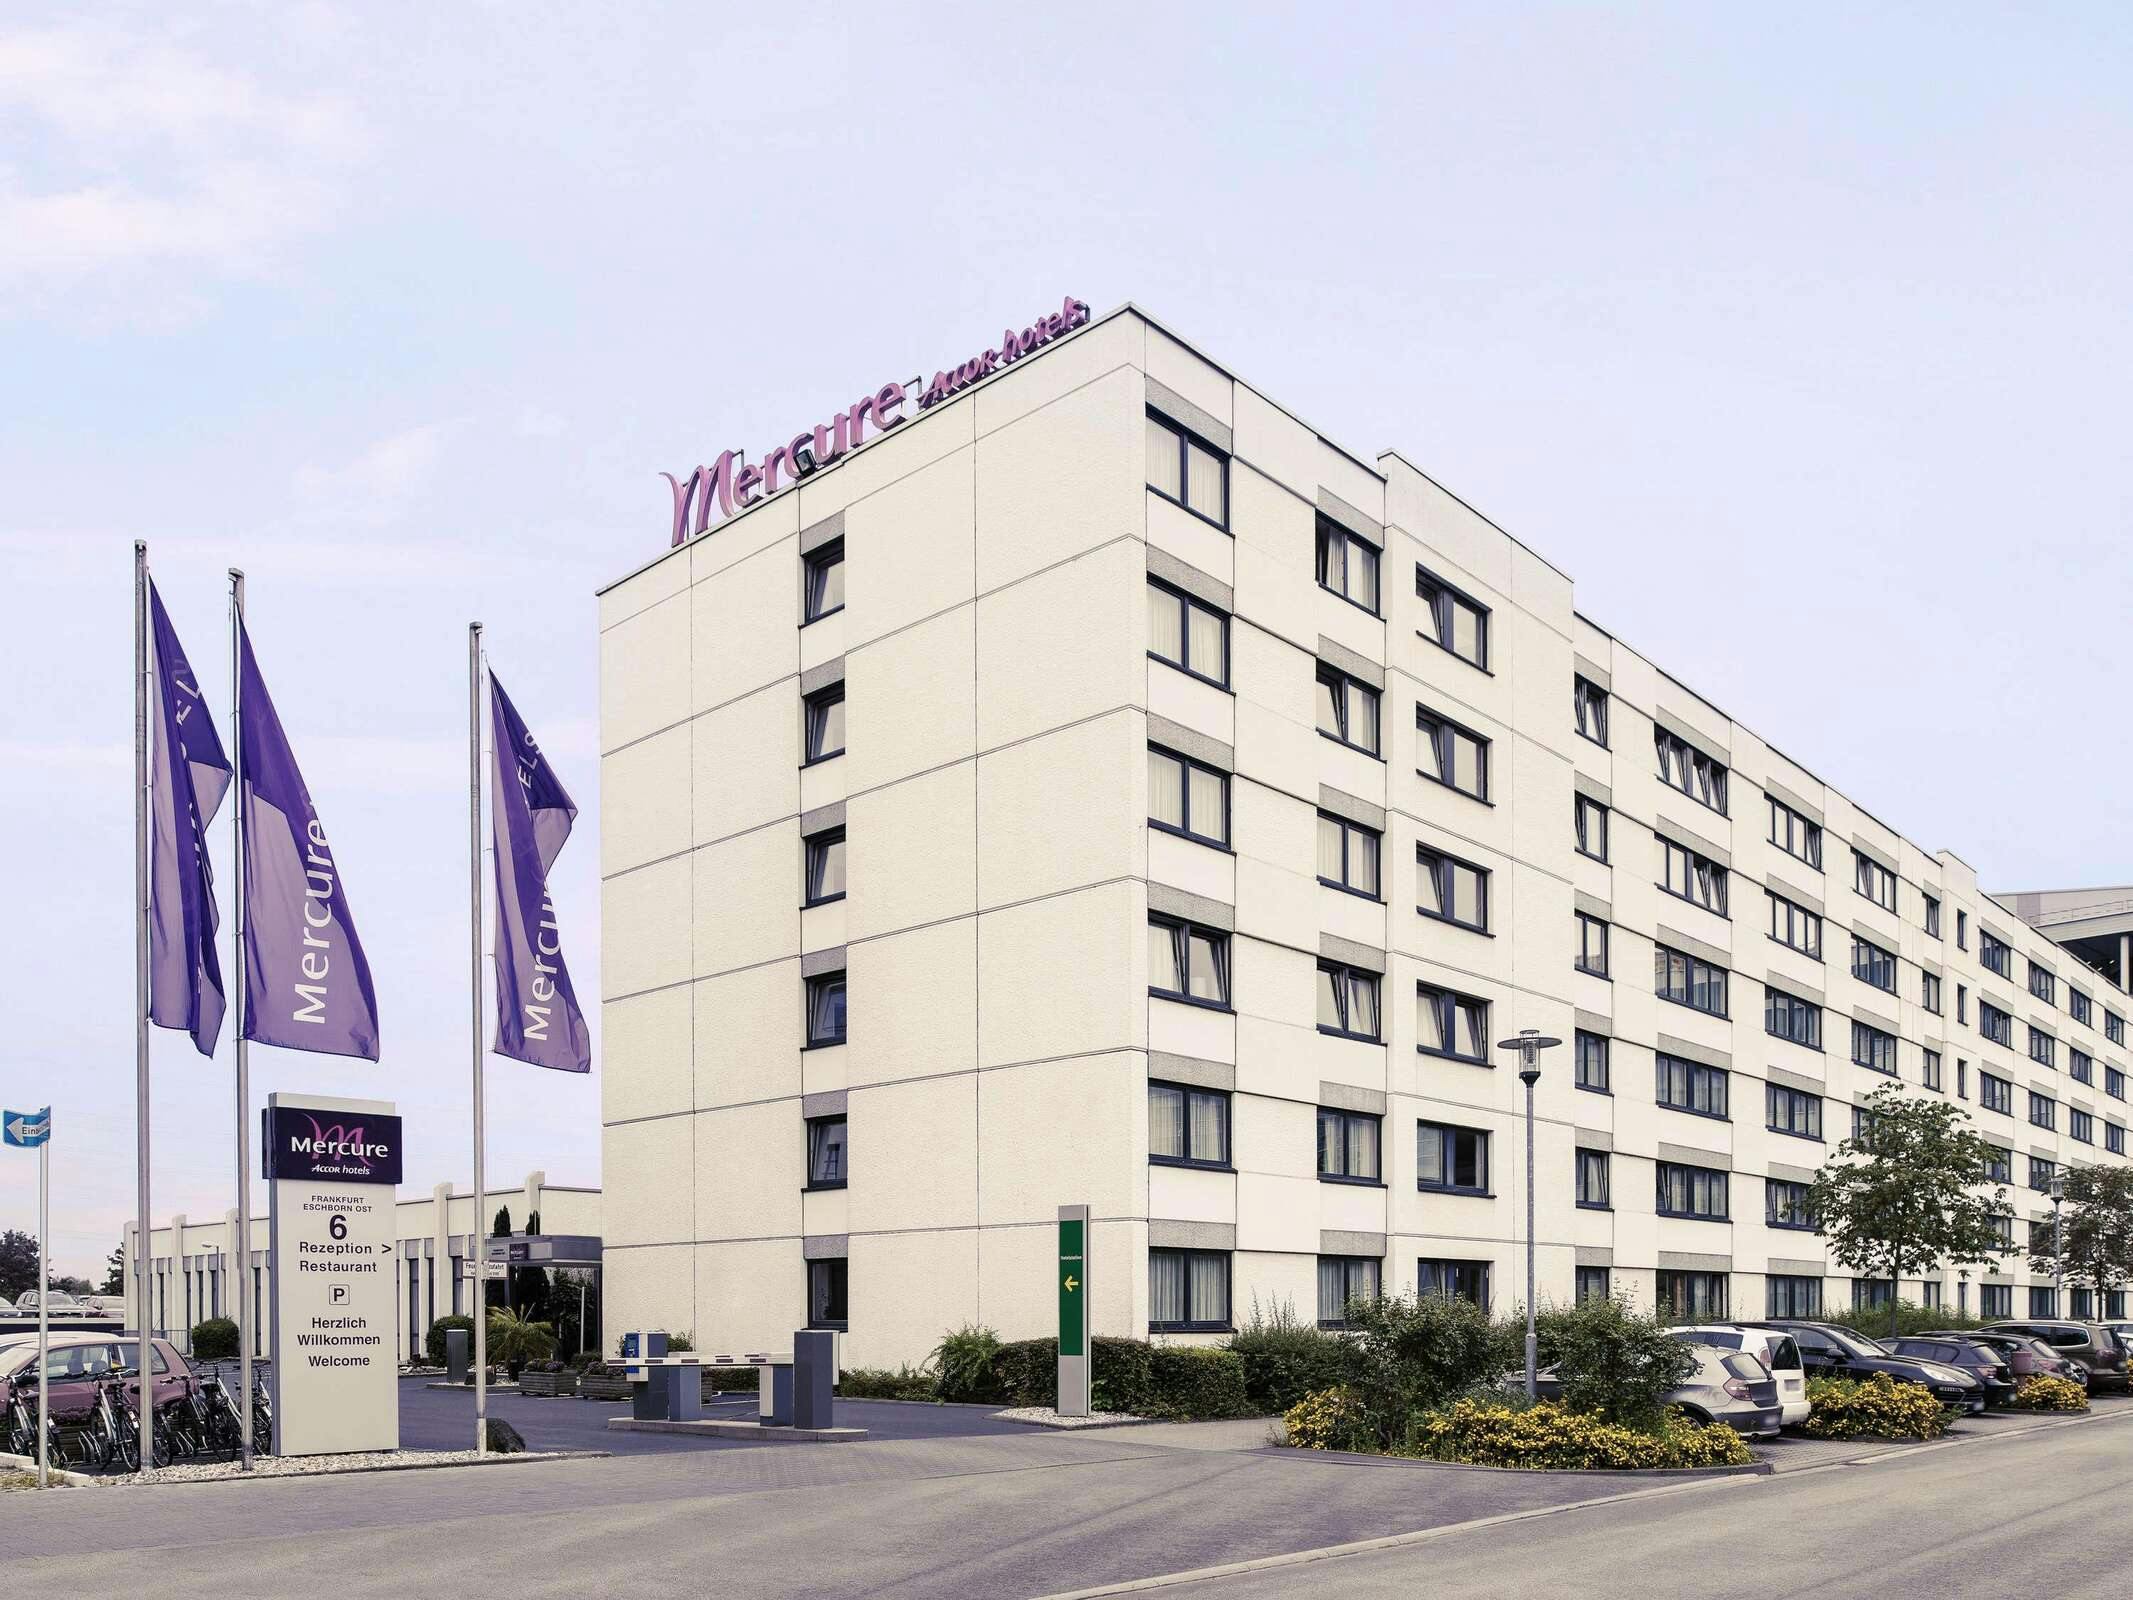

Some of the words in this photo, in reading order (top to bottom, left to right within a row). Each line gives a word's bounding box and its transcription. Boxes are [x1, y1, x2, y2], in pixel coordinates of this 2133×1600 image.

[659, 382, 907, 548] Mercure
[293, 819, 334, 1024] Mercure
[524, 880, 560, 1041] Mercu
[291, 1136, 388, 1157] Mercure
[342, 1165, 370, 1175] hotels
[311, 1195, 364, 1204] FRANKFURT
[303, 1203, 353, 1212] ESCHBORN
[355, 1205, 372, 1213] OST
[329, 1214, 347, 1240] 6
[299, 1241, 372, 1255] Rezeption
[299, 1260, 377, 1272] Restaurant
[333, 1288, 345, 1302] P
[311, 1317, 367, 1329] Herzlich
[297, 1334, 380, 1346] Willkommen
[308, 1355, 370, 1367] Welcome
